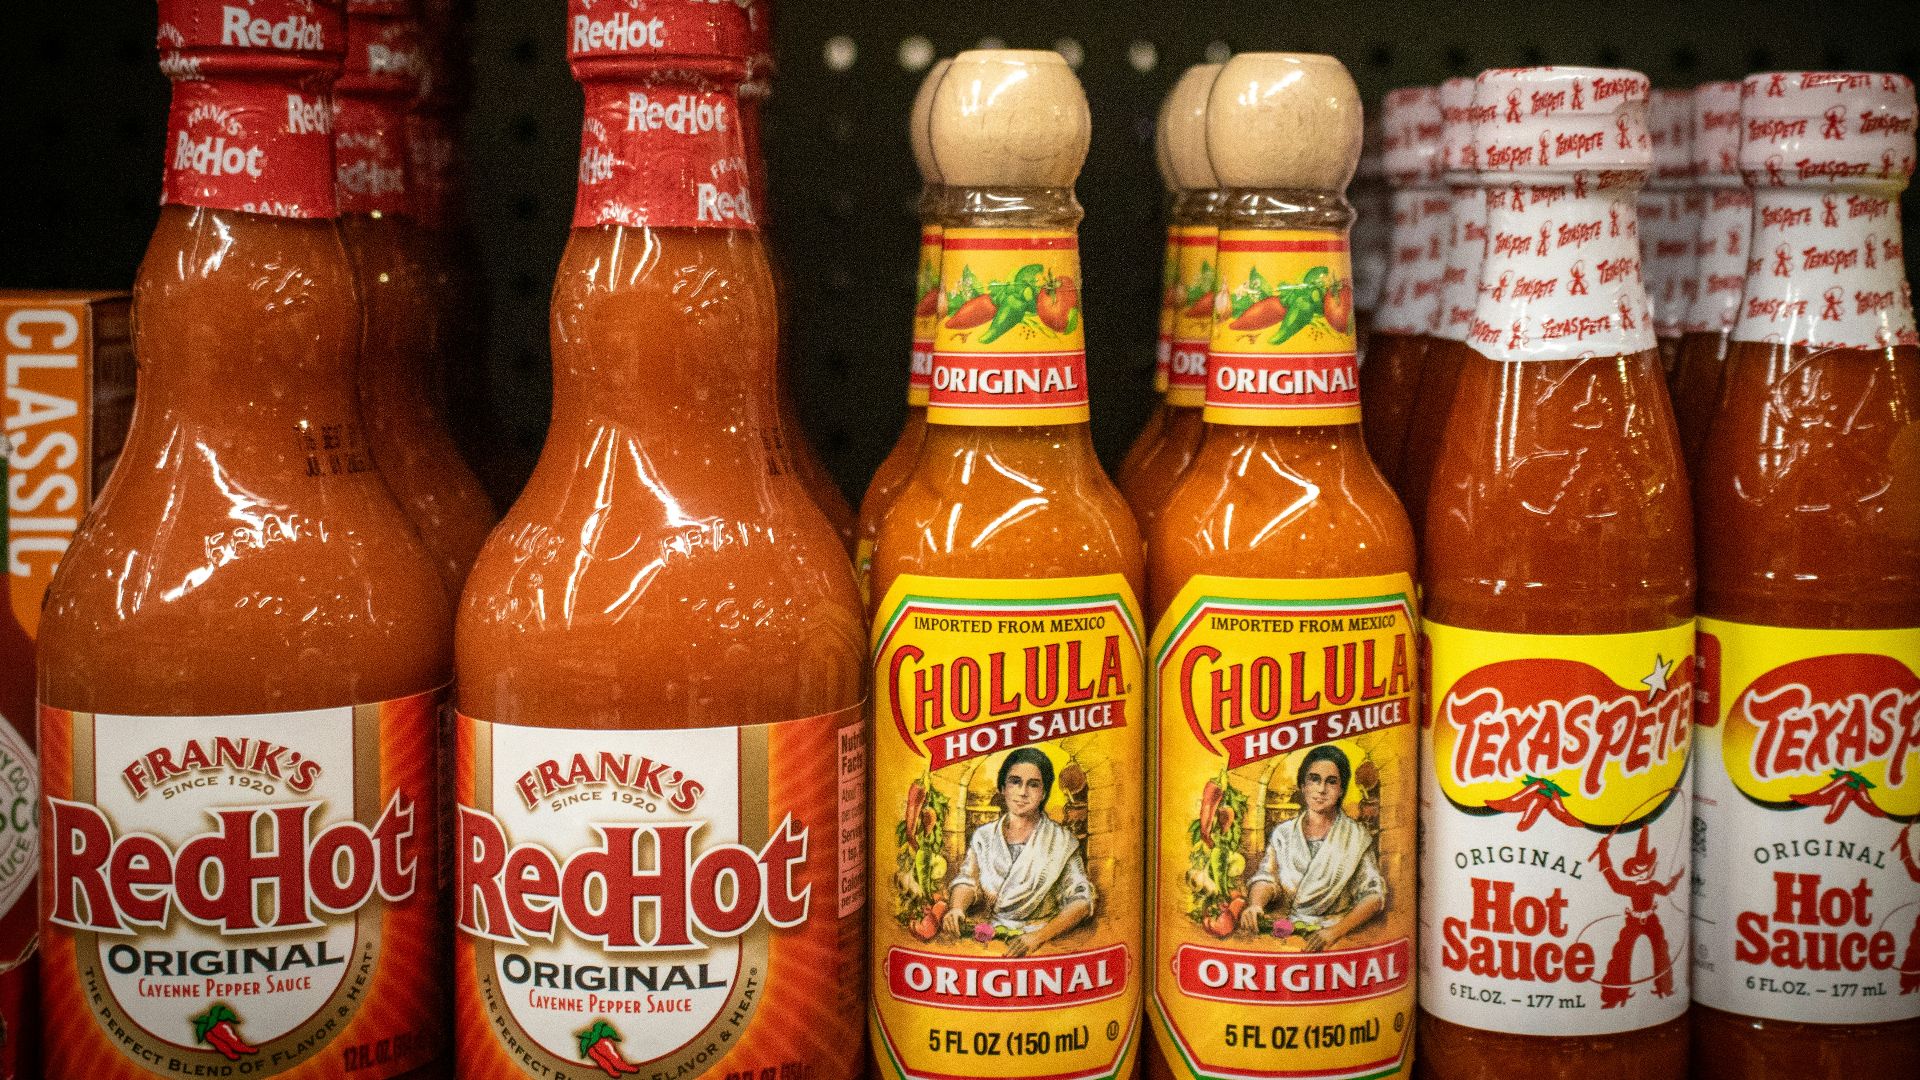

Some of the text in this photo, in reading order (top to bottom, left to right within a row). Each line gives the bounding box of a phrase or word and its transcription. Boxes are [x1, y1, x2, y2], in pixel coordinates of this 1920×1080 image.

[222, 6, 324, 50] RedHot
[573, 12, 664, 53] RedHot
[627, 92, 727, 135] RedHot
[174, 131, 264, 177] RedHot
[933, 365, 1079, 395] ORIGINAL
[1216, 366, 1357, 395] ORIGINAL
[5, 309, 79, 578] CLASSIC
[914, 616, 1105, 635] IMPORTED FROM MEXICO
[1211, 614, 1396, 634] IMPORTED FROM MEXICO
[889, 635, 1126, 759] CHOLULA
[1180, 634, 1410, 758] CHOLULA
[945, 703, 1113, 760] HOT SAUCE
[1243, 701, 1402, 760] HOT SAUCE
[122, 736, 323, 799] FRANK'S
[163, 775, 275, 800] SINCE 1920
[515, 751, 706, 812] FRANK'S
[552, 791, 658, 814] SINCE 1920
[47, 788, 418, 935] RedHot
[1455, 846, 1583, 880] ORIGINAL
[1754, 839, 1887, 870] ORIGINAL
[455, 803, 813, 951] RedHot
[1470, 877, 1569, 938] Hot
[1773, 871, 1874, 928] Hot
[108, 941, 344, 977] ORIGINAL
[1442, 916, 1595, 983] Sauce
[1735, 911, 1895, 972] Sauce
[503, 953, 728, 993] ORIGINAL
[904, 960, 1114, 998] ORIGINAL
[1199, 953, 1400, 993] ORIGINAL
[1746, 976, 1756, 990] 6
[1832, 983, 1859, 998] 177
[1863, 982, 1888, 997] mL
[1450, 982, 1458, 997] 6
[1527, 994, 1554, 1009] 177
[1559, 995, 1586, 1009] mL
[85, 966, 102, 1003] THE
[101, 1007, 162, 1066] PERFECT
[168, 1058, 232, 1077] BLEND
[239, 1060, 266, 1074] OF
[271, 1021, 338, 1067] FLAVOR
[483, 975, 501, 1011] THE
[495, 1016, 552, 1077] PERFECT
[929, 1025, 1090, 1056] 5 FL OZ (150 mL)
[1225, 1017, 1380, 1049] 5 FL OZ (150 mL)
